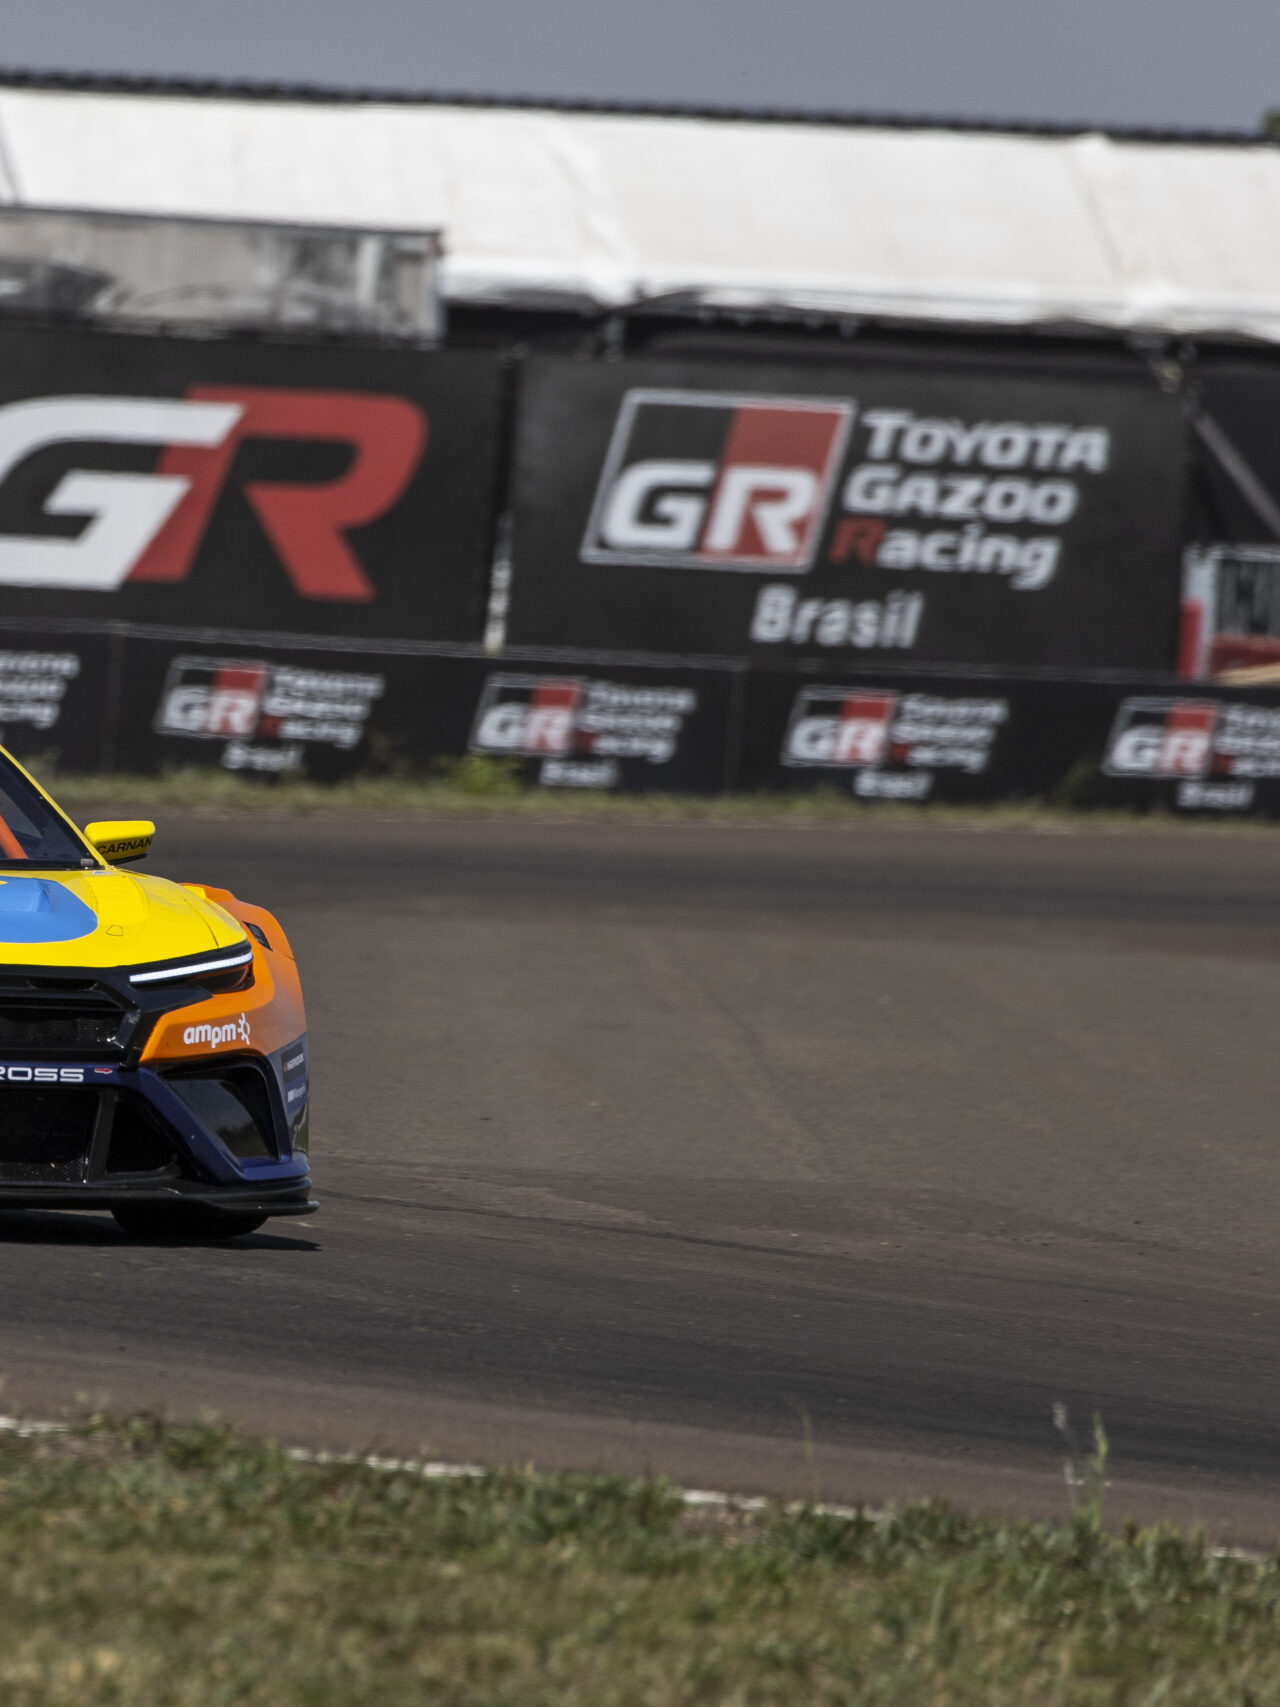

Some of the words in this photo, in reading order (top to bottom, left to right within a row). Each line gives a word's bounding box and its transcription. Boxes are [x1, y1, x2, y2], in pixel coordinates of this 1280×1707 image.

[862, 409, 1108, 473] TOYOTA
[597, 459, 819, 556] GR
[842, 464, 1079, 524] GAZOO
[829, 517, 1061, 590] Racing
[750, 584, 924, 648] Brasil
[163, 685, 259, 733] GR
[476, 701, 571, 751] GR
[789, 715, 886, 762] GR
[1111, 724, 1211, 774] GR
[97, 836, 152, 855] CARNAN
[183, 1021, 237, 1049] ampm
